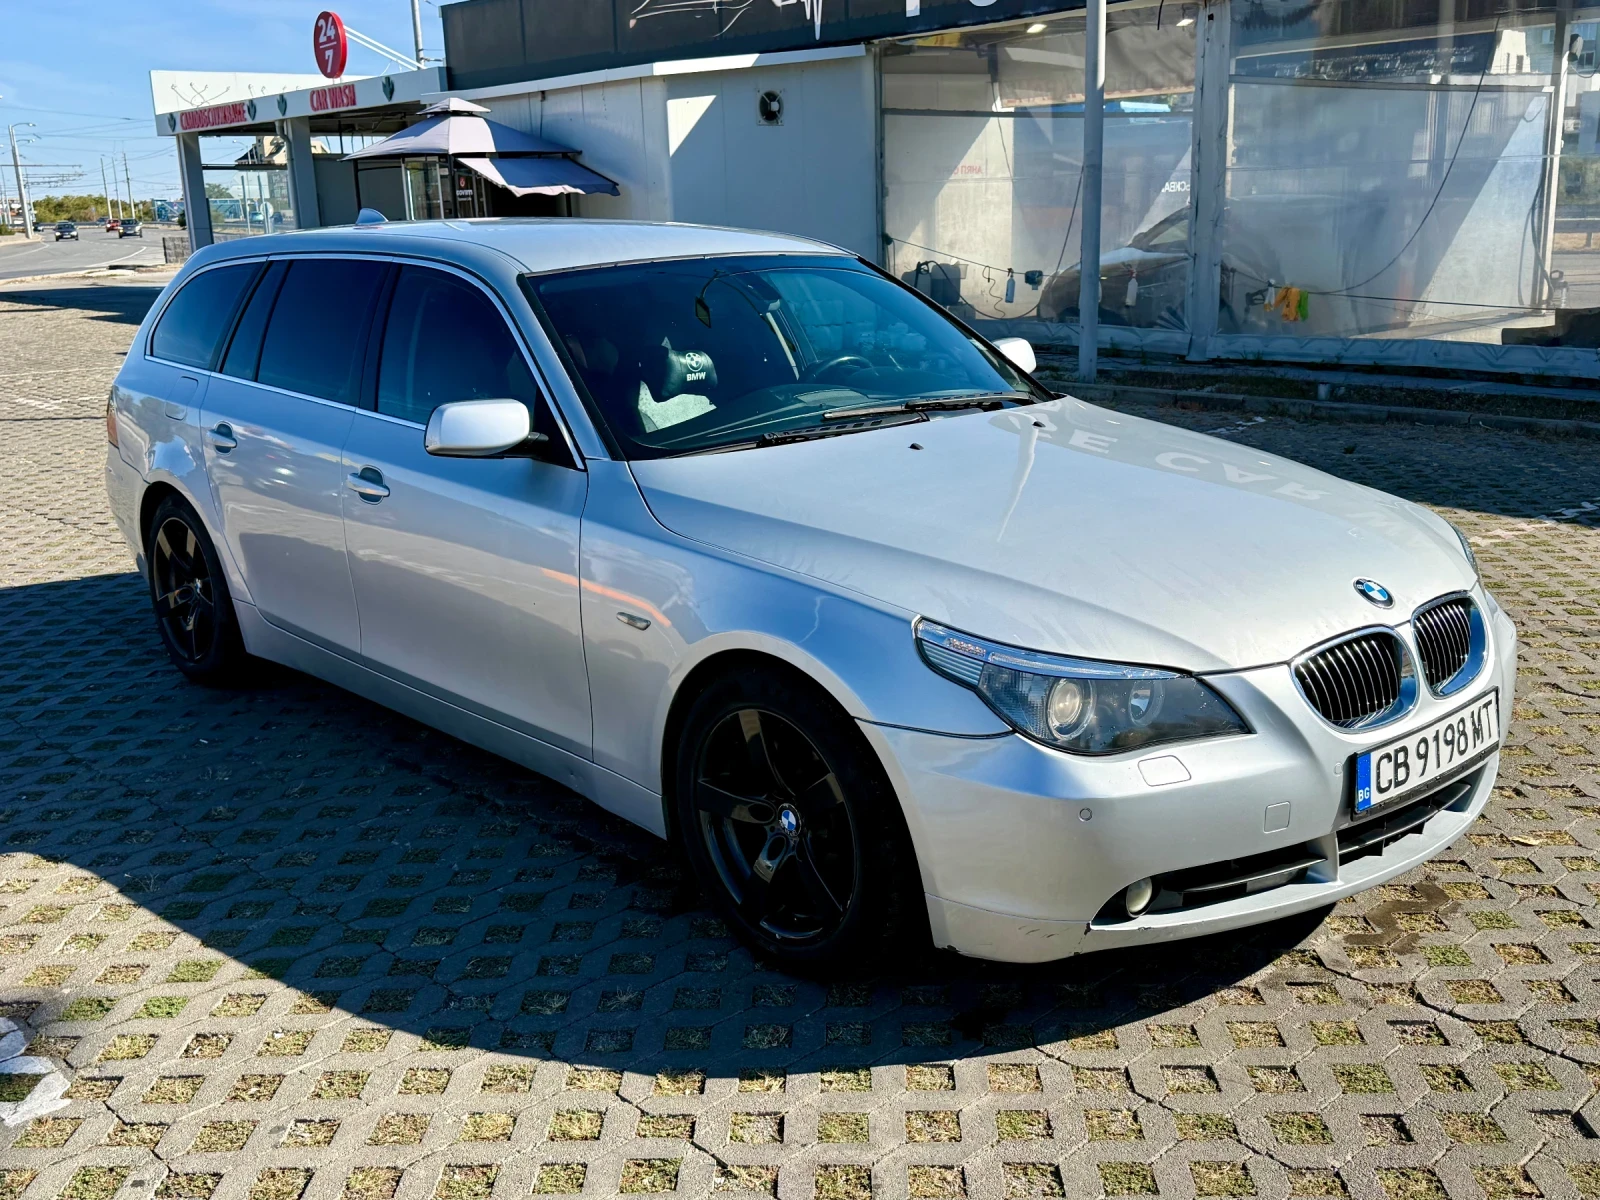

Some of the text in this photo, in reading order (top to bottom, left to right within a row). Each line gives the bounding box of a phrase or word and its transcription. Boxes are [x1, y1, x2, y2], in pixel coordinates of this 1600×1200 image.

[318, 17, 336, 43] 24
[325, 50, 334, 73] 7
[309, 84, 357, 112] CAR WASH
[686, 371, 706, 381] BMW
[1375, 699, 1493, 795] CB 9198 MT
[1358, 787, 1370, 802] BG
